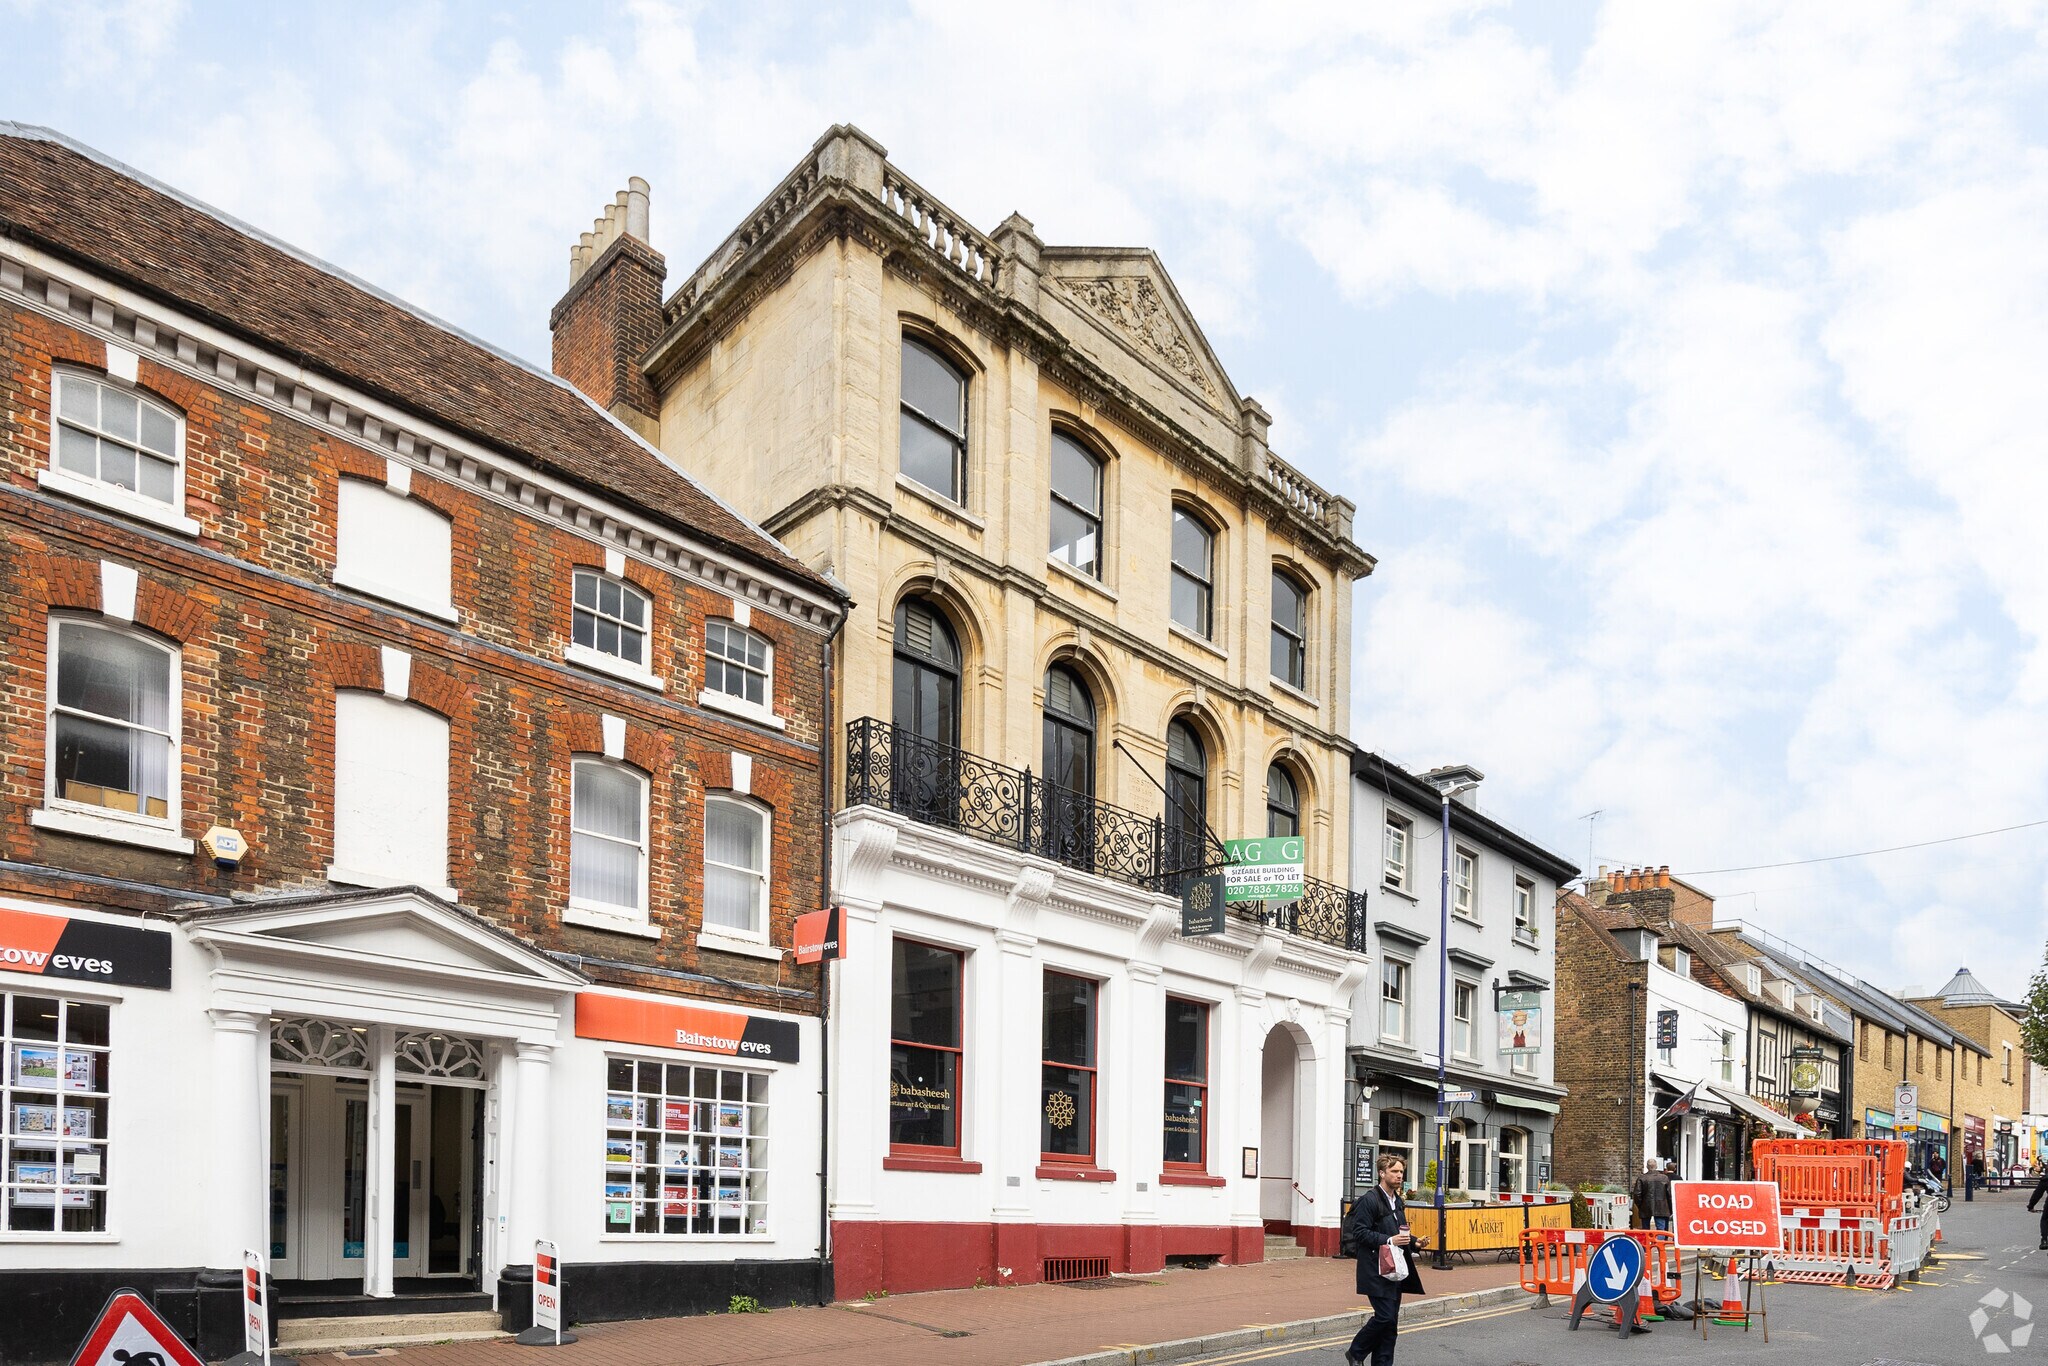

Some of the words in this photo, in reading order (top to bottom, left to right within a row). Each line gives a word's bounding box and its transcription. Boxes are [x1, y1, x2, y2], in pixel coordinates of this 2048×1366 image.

[1230, 843, 1262, 861] AG
[1281, 841, 1299, 860] G
[1227, 886, 1245, 895] 020
[1248, 885, 1271, 894] 7836
[1275, 884, 1299, 893] 7826
[798, 944, 823, 955] Bairstow
[824, 940, 838, 950] eves
[52, 954, 113, 975] eves
[675, 1029, 740, 1050] Bairstow
[741, 1042, 771, 1054] eves
[900, 1084, 950, 1099] babasheesh
[919, 1102, 940, 1110] Cocktail
[1165, 1113, 1198, 1124] babasheesh
[1697, 1193, 1753, 1209] ROAD
[1689, 1219, 1767, 1236] CLOSED
[538, 1293, 556, 1310] OPEN
[248, 1313, 261, 1332] OPEN
